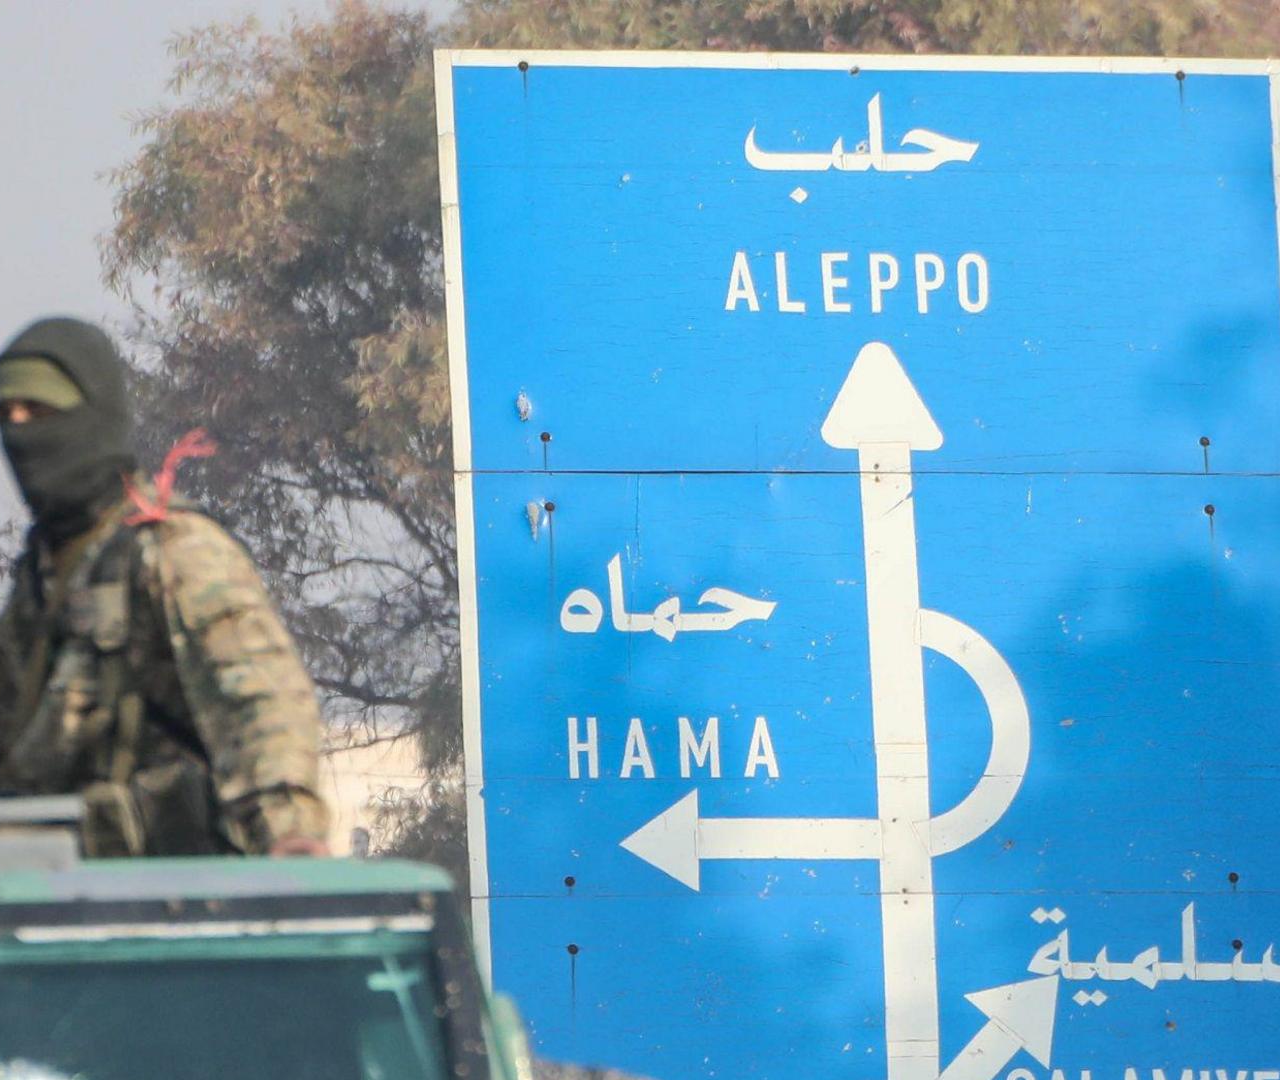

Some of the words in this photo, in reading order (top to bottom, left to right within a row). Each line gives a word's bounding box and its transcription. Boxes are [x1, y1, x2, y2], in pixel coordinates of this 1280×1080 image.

[744, 93, 979, 204] حلب
[725, 252, 989, 313] ALEPPO
[560, 554, 777, 642] حماه
[567, 717, 780, 778] HAMA
